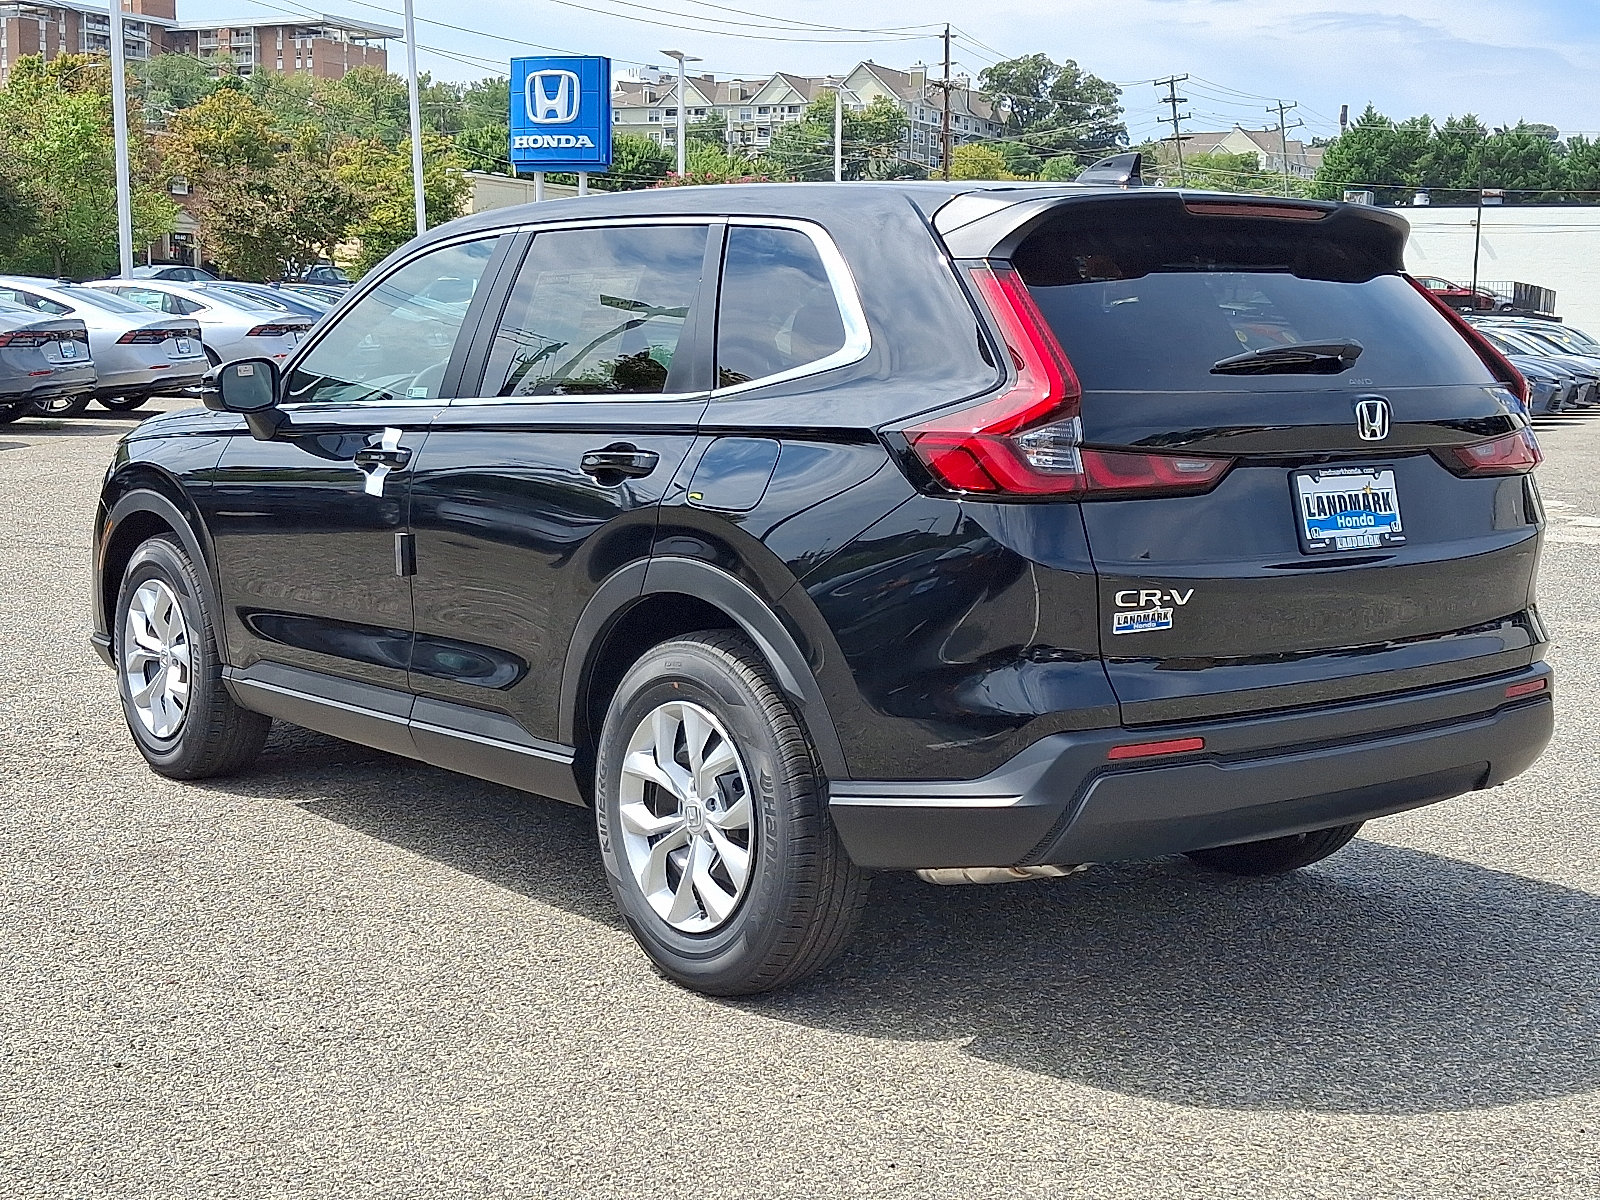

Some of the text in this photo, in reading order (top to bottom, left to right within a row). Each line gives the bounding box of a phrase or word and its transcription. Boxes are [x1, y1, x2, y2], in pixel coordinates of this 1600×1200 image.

[513, 135, 595, 148] HONDA
[1305, 491, 1393, 518] LANDMARK
[1336, 513, 1375, 528] Honda
[1336, 534, 1382, 549] LANDMARK
[1115, 588, 1195, 607] CR-V
[1117, 611, 1169, 626] LANDMARK
[1133, 621, 1157, 630] Honda
